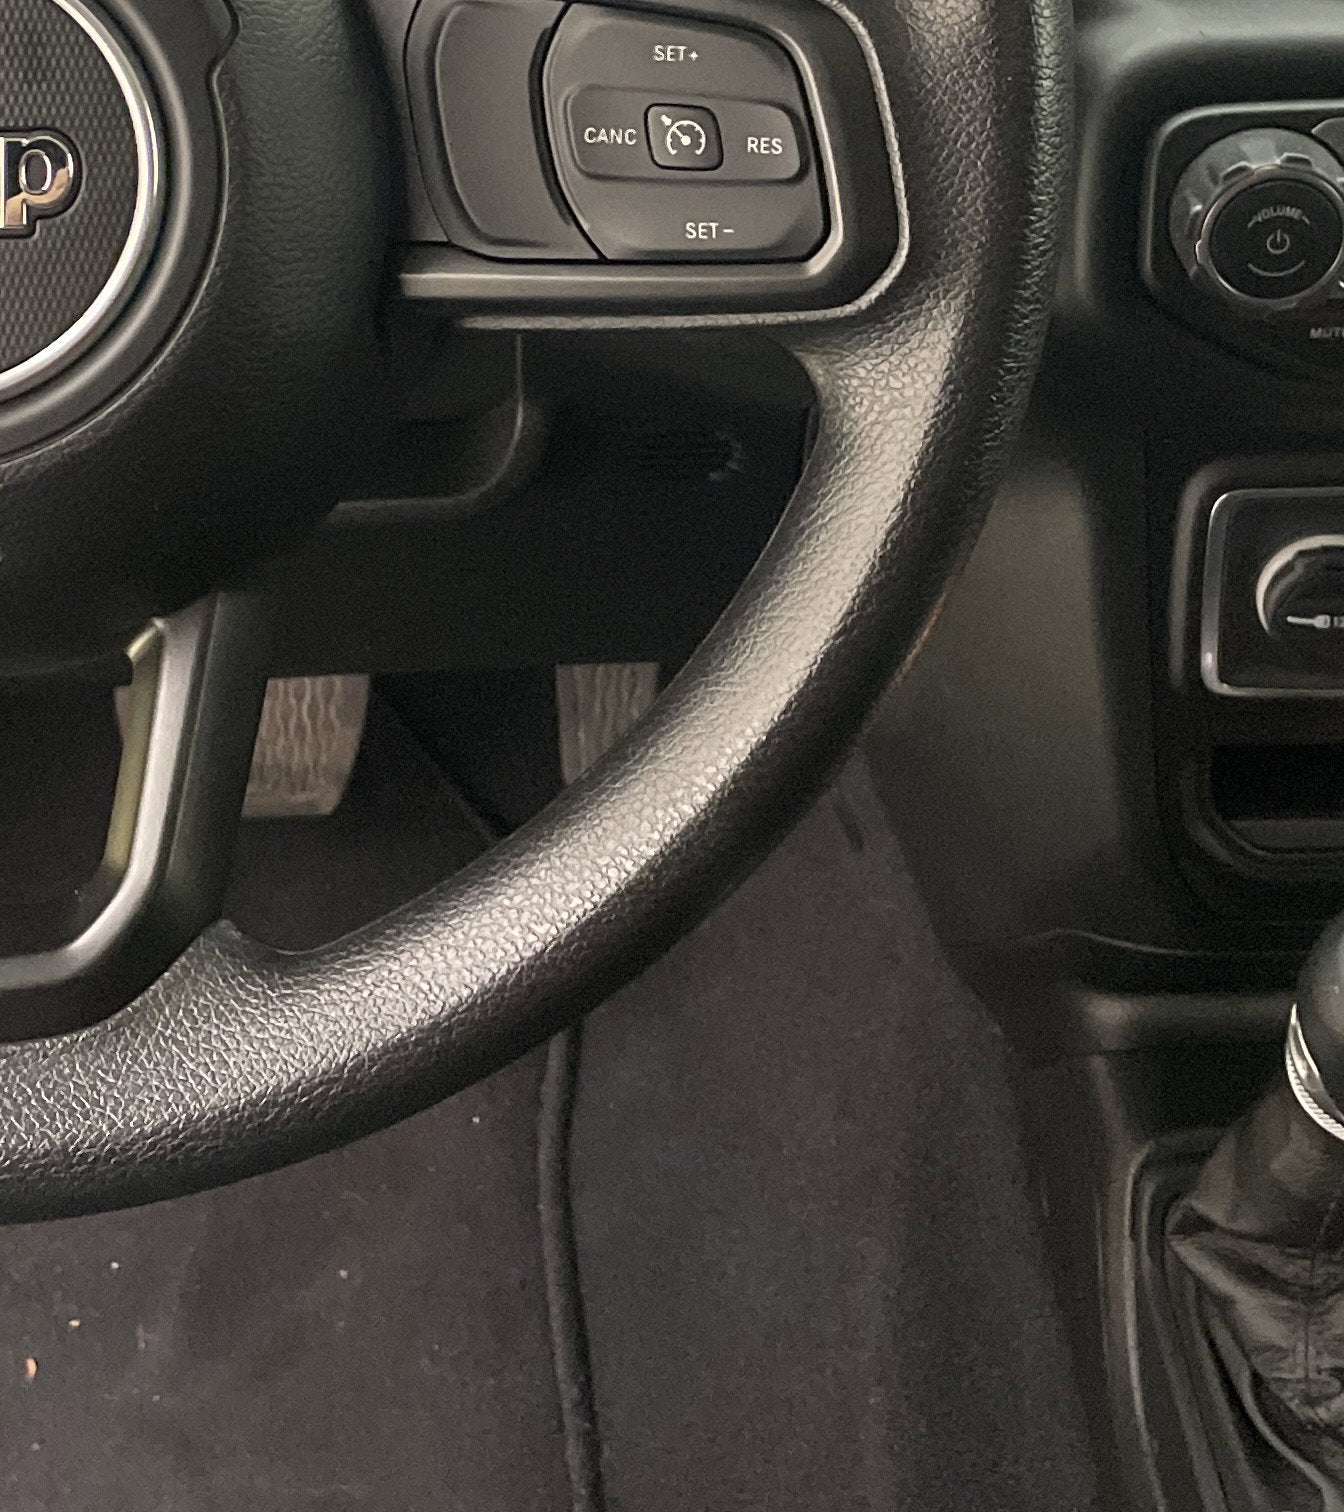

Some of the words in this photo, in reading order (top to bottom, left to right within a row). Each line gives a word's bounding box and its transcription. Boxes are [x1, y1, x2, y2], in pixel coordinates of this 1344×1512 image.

[583, 127, 637, 146] CANC
[746, 137, 783, 155] RES
[1253, 205, 1304, 223] VOLUME
